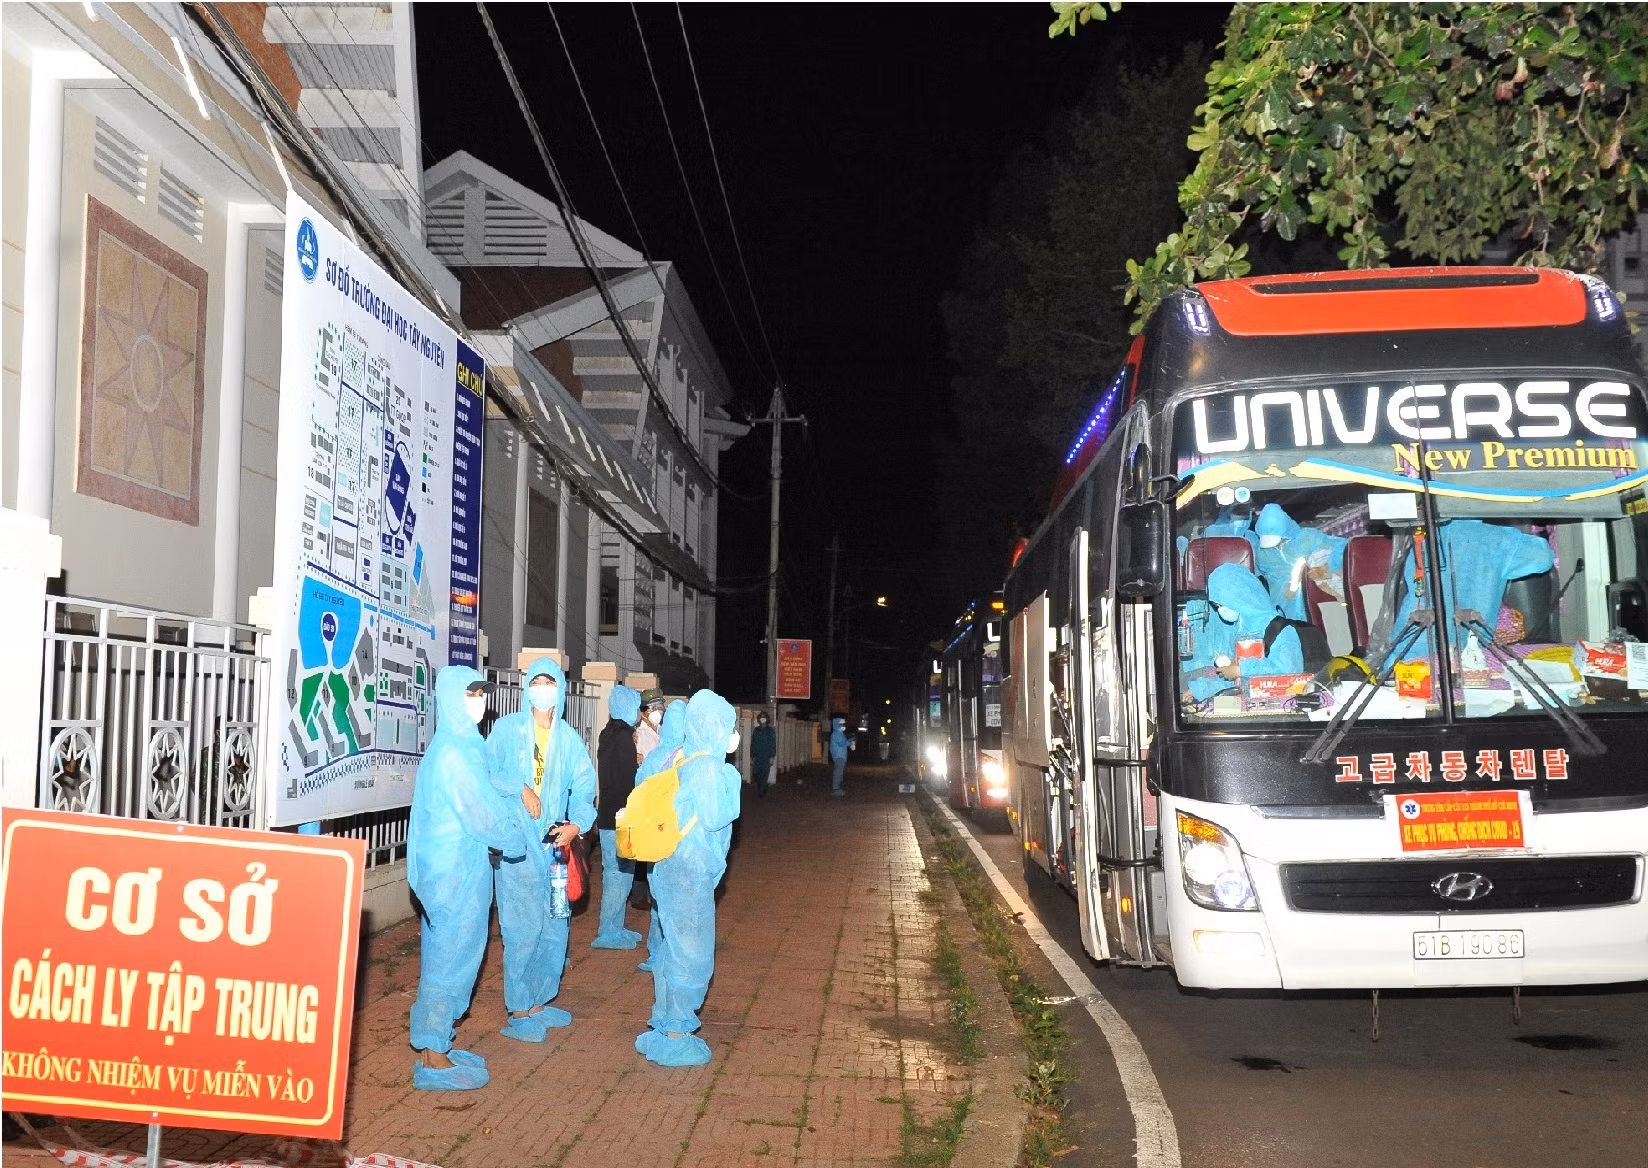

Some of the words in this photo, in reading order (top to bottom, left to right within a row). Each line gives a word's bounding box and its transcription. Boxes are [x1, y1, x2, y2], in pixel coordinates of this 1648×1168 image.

[326, 257, 337, 286] SƠ
[381, 301, 393, 332] ĐẠI
[1193, 381, 1637, 454] UNIVERSE
[1391, 442, 1472, 473] New
[1481, 439, 1637, 469] Premium
[65, 866, 163, 936] CƠ
[179, 861, 279, 947] SỞ
[9, 948, 97, 1025] CÁCH
[101, 967, 139, 1028] LY
[147, 959, 205, 1047] TẬP
[215, 977, 320, 1044] TRUNG
[2, 1047, 82, 1083] KHÔNG
[87, 1056, 162, 1096] NHIỆM
[166, 1065, 199, 1100] VỤ
[201, 1060, 260, 1100] MIỄN
[267, 1068, 314, 1104] VÀO
